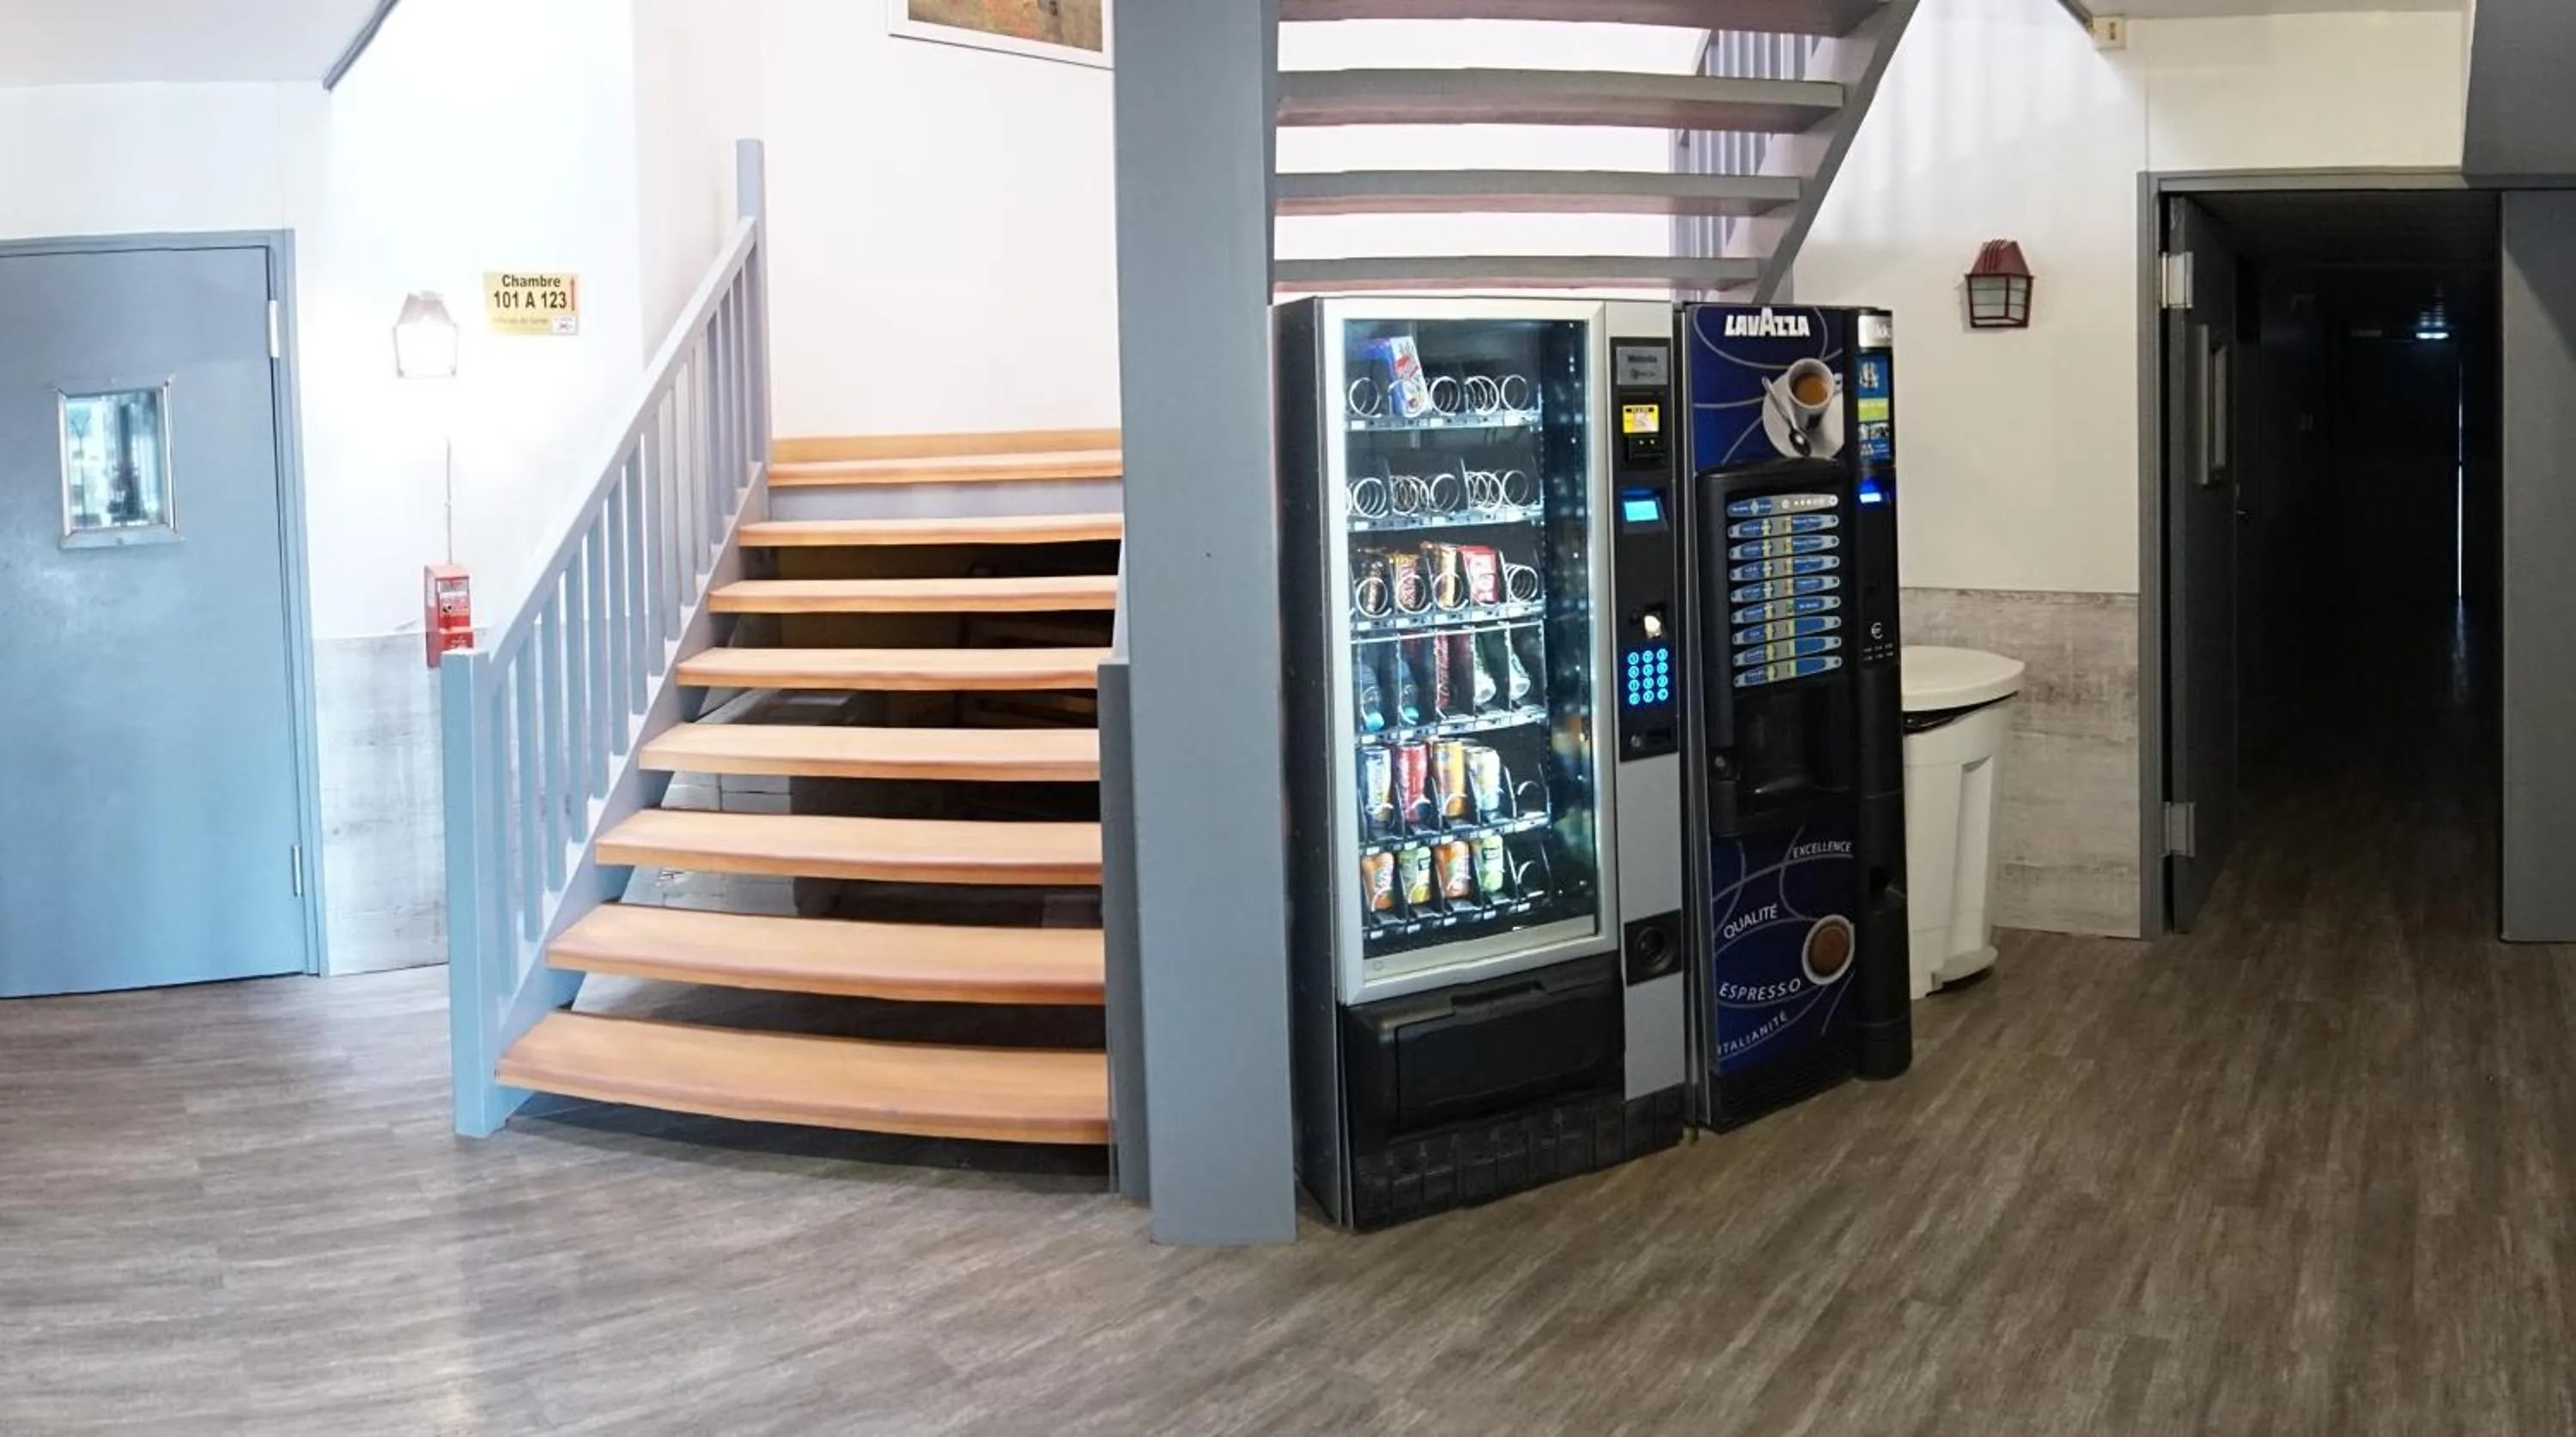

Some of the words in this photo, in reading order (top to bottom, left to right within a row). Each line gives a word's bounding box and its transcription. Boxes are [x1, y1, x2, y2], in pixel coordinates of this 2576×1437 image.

[501, 274, 561, 287] Chambre
[494, 290, 519, 308] 101
[526, 291, 536, 308] A
[541, 291, 567, 308] 123
[1724, 306, 1811, 337] LAVAZZA
[1793, 841, 1853, 858] EXCELLENCE
[1723, 903, 1777, 939] QUALITÉ
[1719, 978, 1801, 1001] ESPRESSO
